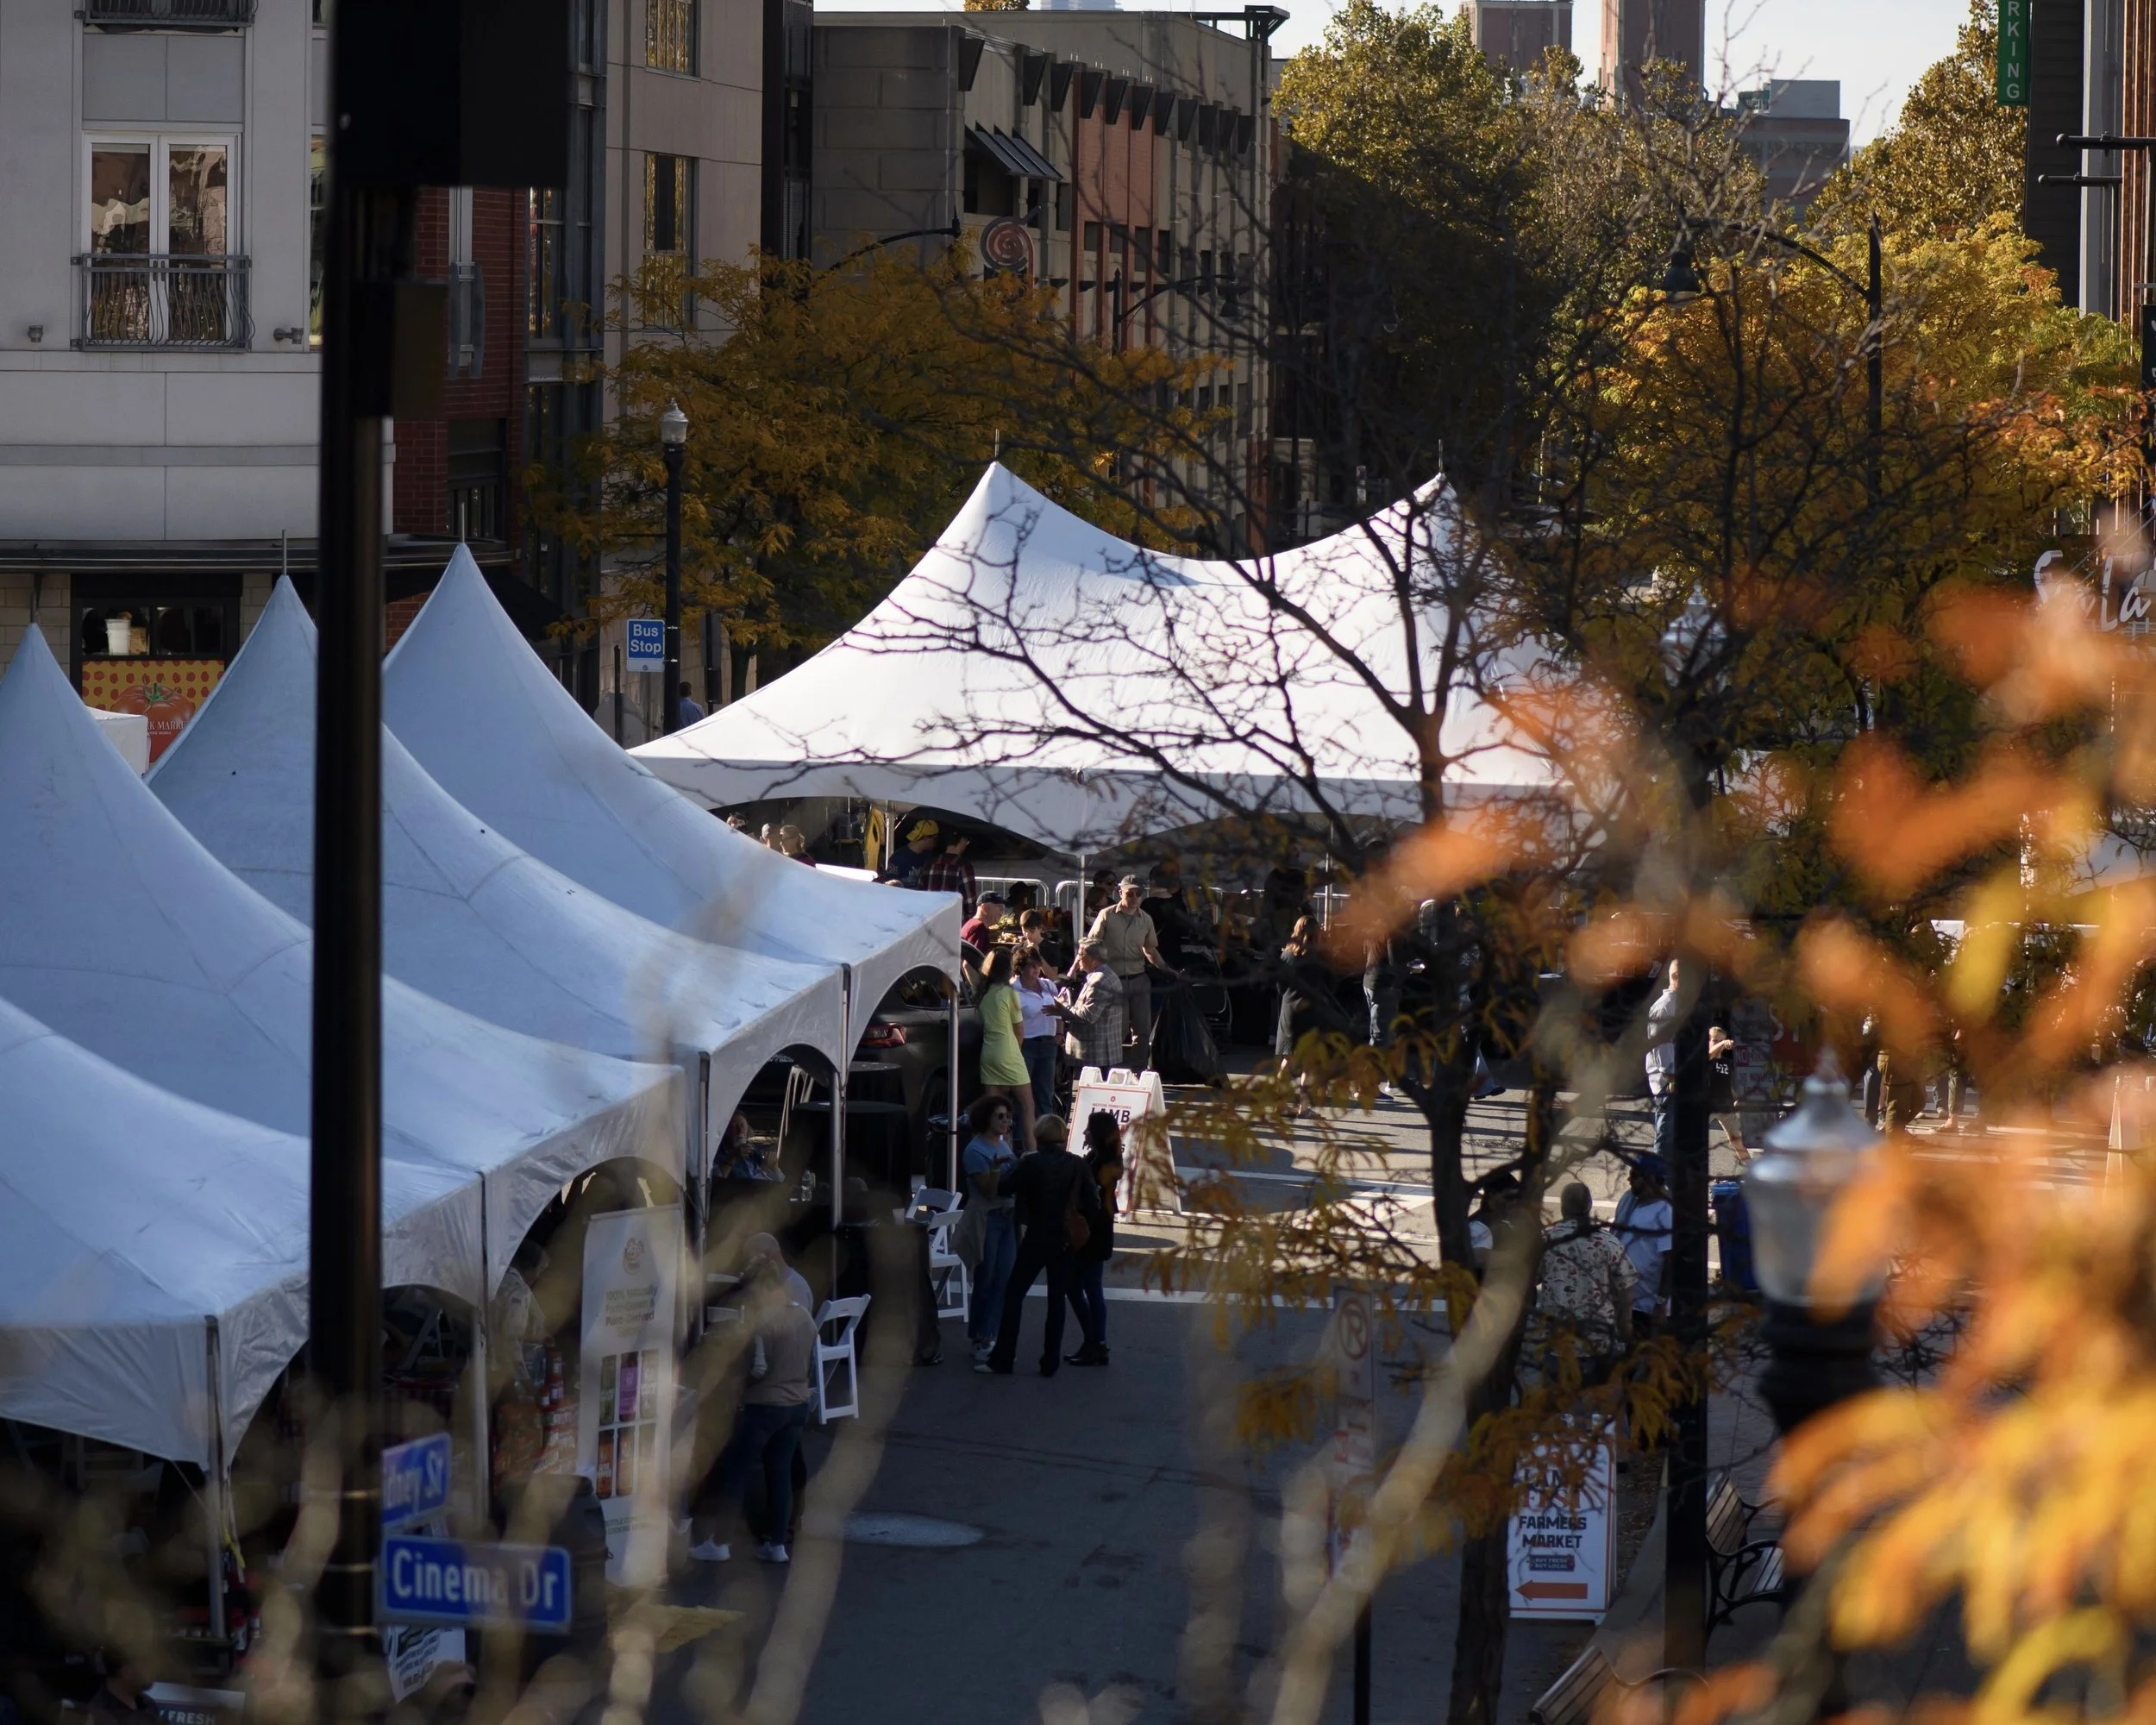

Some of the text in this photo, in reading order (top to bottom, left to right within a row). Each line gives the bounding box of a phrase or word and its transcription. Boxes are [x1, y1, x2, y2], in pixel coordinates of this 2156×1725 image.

[2006, 1, 2020, 99] RKING
[633, 624, 659, 637] Bus
[630, 639, 661, 655] Stop
[1092, 1107, 1131, 1123] MB
[425, 1449, 443, 1499] St
[1523, 1534, 1583, 1548] MARKET
[392, 1548, 558, 1610] Cinema Dr
[168, 1710, 216, 1725] FRESH
